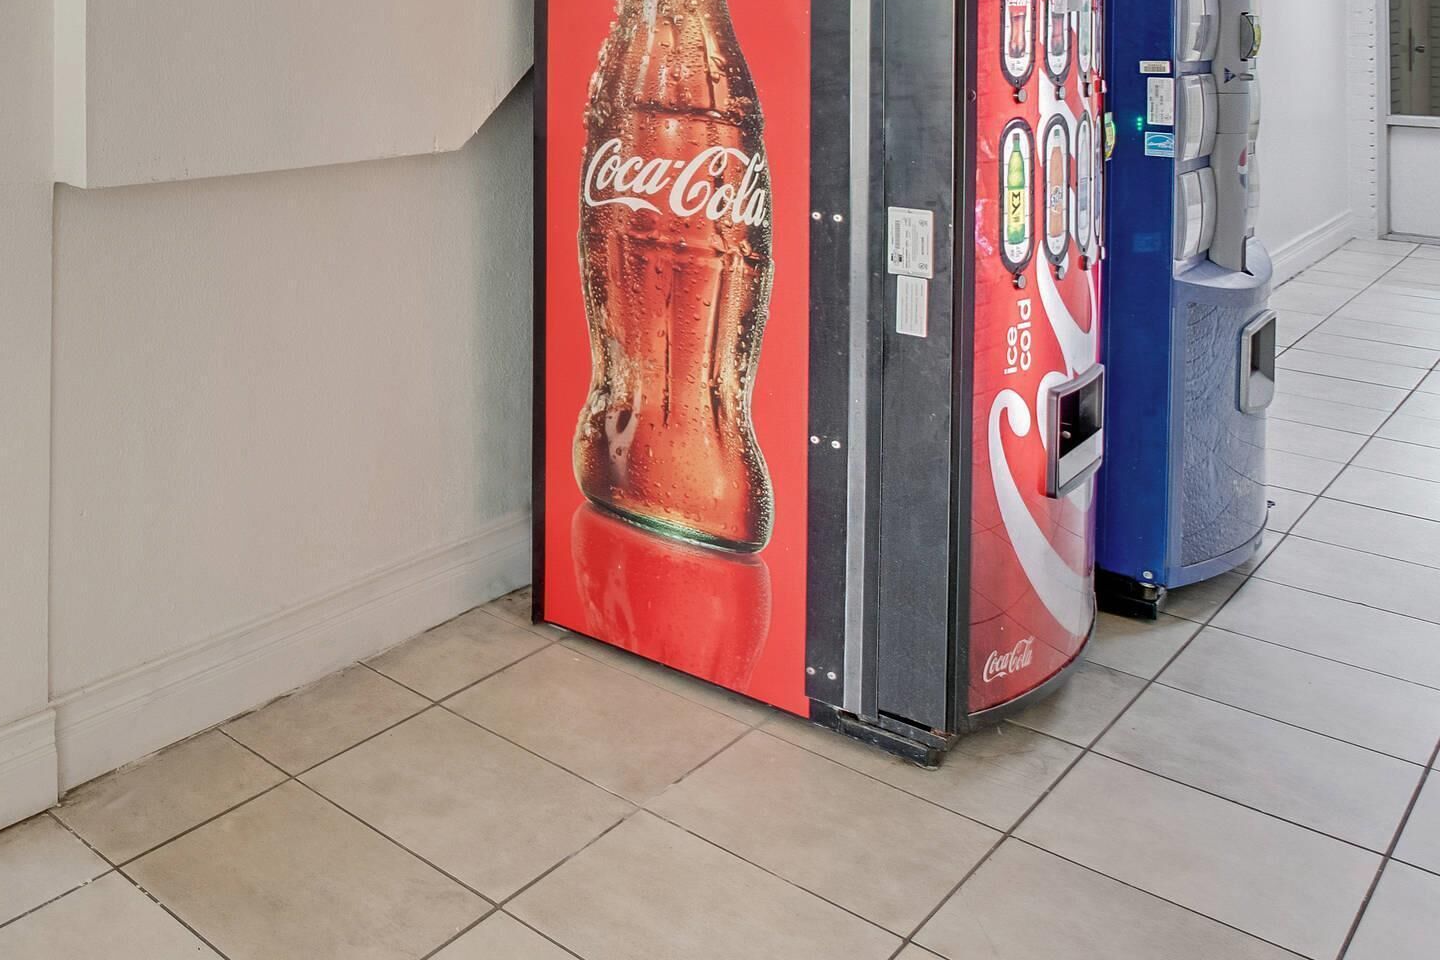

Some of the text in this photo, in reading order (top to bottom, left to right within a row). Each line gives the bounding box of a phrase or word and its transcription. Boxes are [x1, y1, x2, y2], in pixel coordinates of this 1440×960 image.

[584, 137, 769, 228] Coca-Cola
[1003, 326, 1018, 375] ice
[1016, 298, 1031, 371] cold
[983, 636, 1034, 683] Coca-Cola
